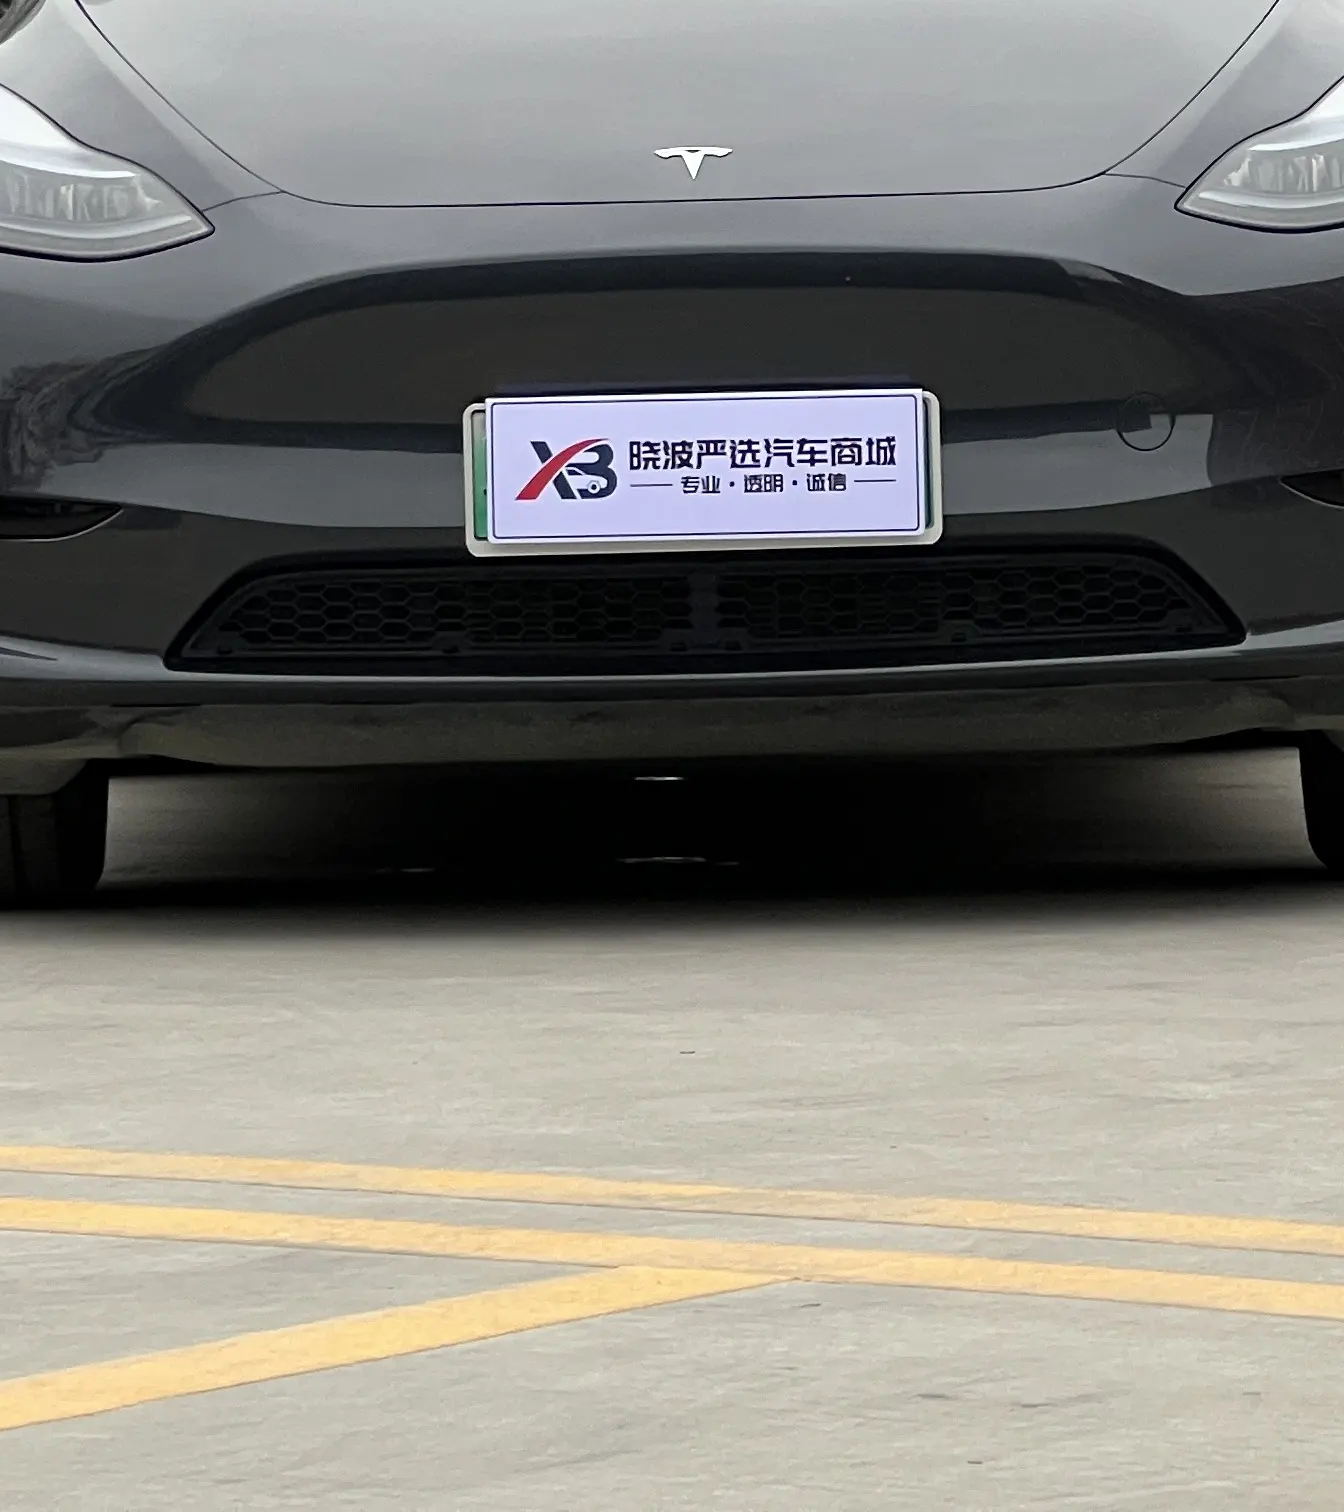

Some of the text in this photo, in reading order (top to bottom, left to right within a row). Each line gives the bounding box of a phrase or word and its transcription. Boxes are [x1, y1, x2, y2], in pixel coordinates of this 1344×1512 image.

[629, 436, 897, 470] 晓波严选汽车商城
